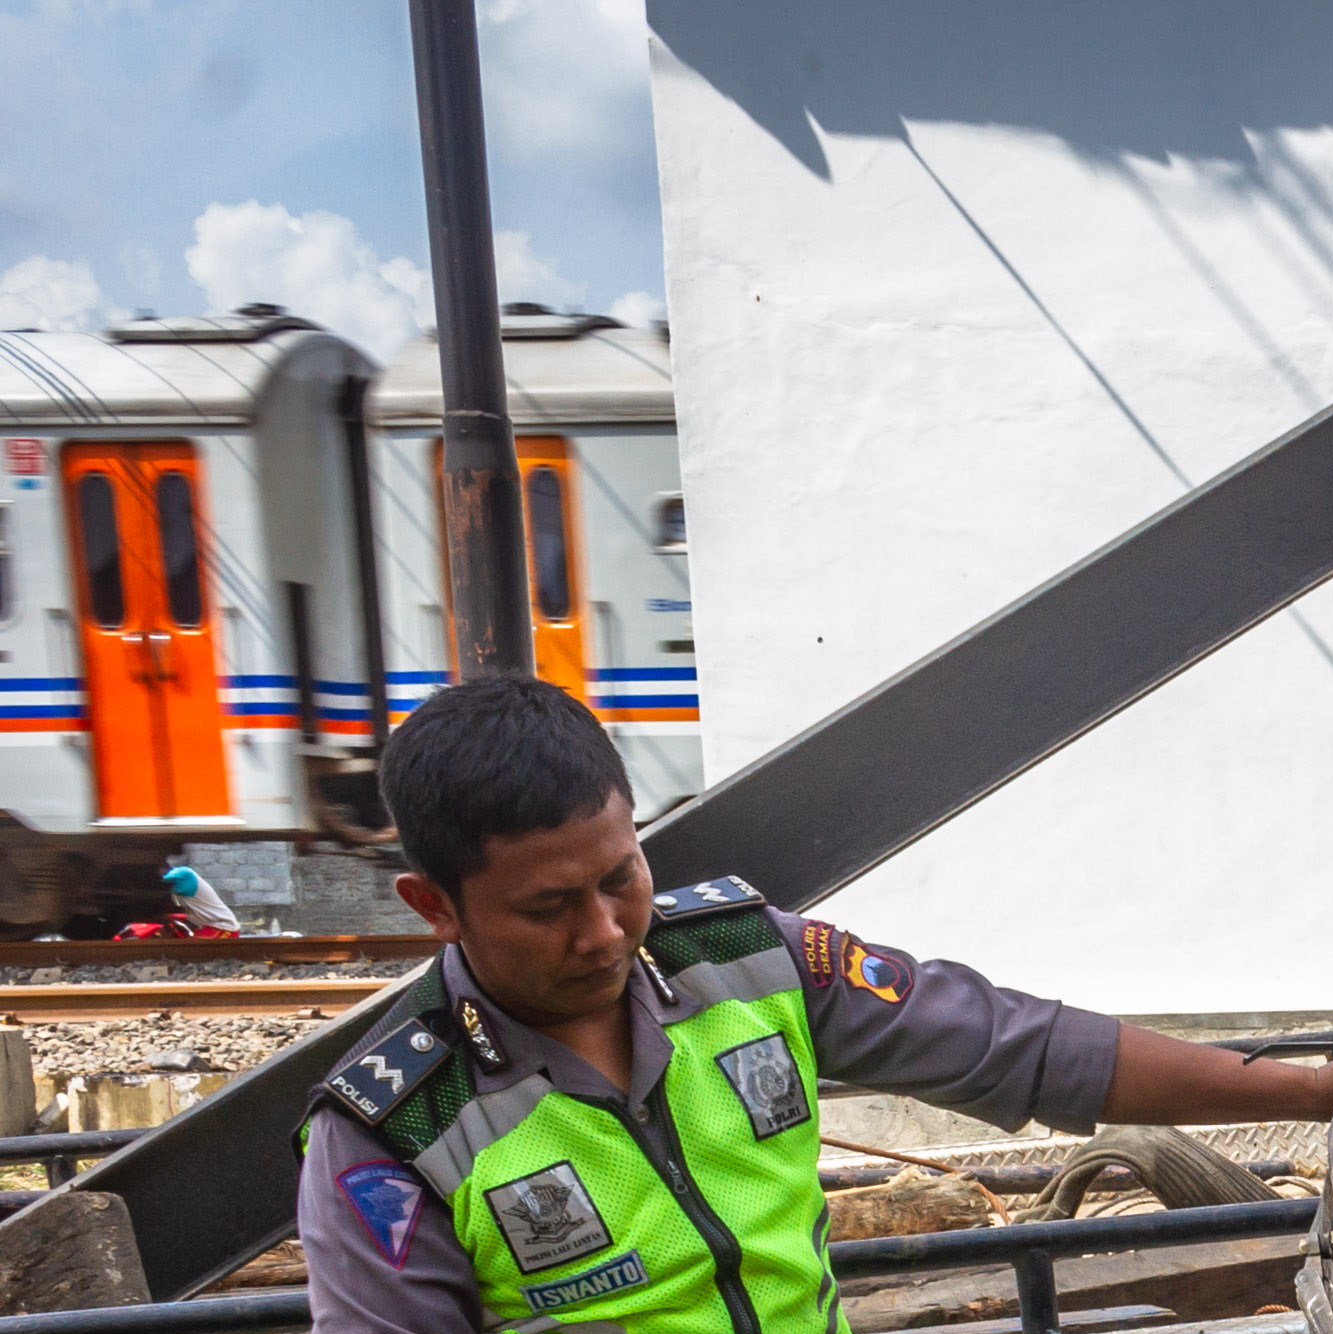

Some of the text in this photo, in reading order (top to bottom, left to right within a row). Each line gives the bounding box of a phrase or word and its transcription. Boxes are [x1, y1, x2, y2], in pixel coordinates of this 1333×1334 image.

[819, 928, 831, 973] DEMAK
[332, 1076, 379, 1115] POLISI
[766, 1106, 801, 1128] POLRI
[533, 1261, 639, 1308] ISWANTO
